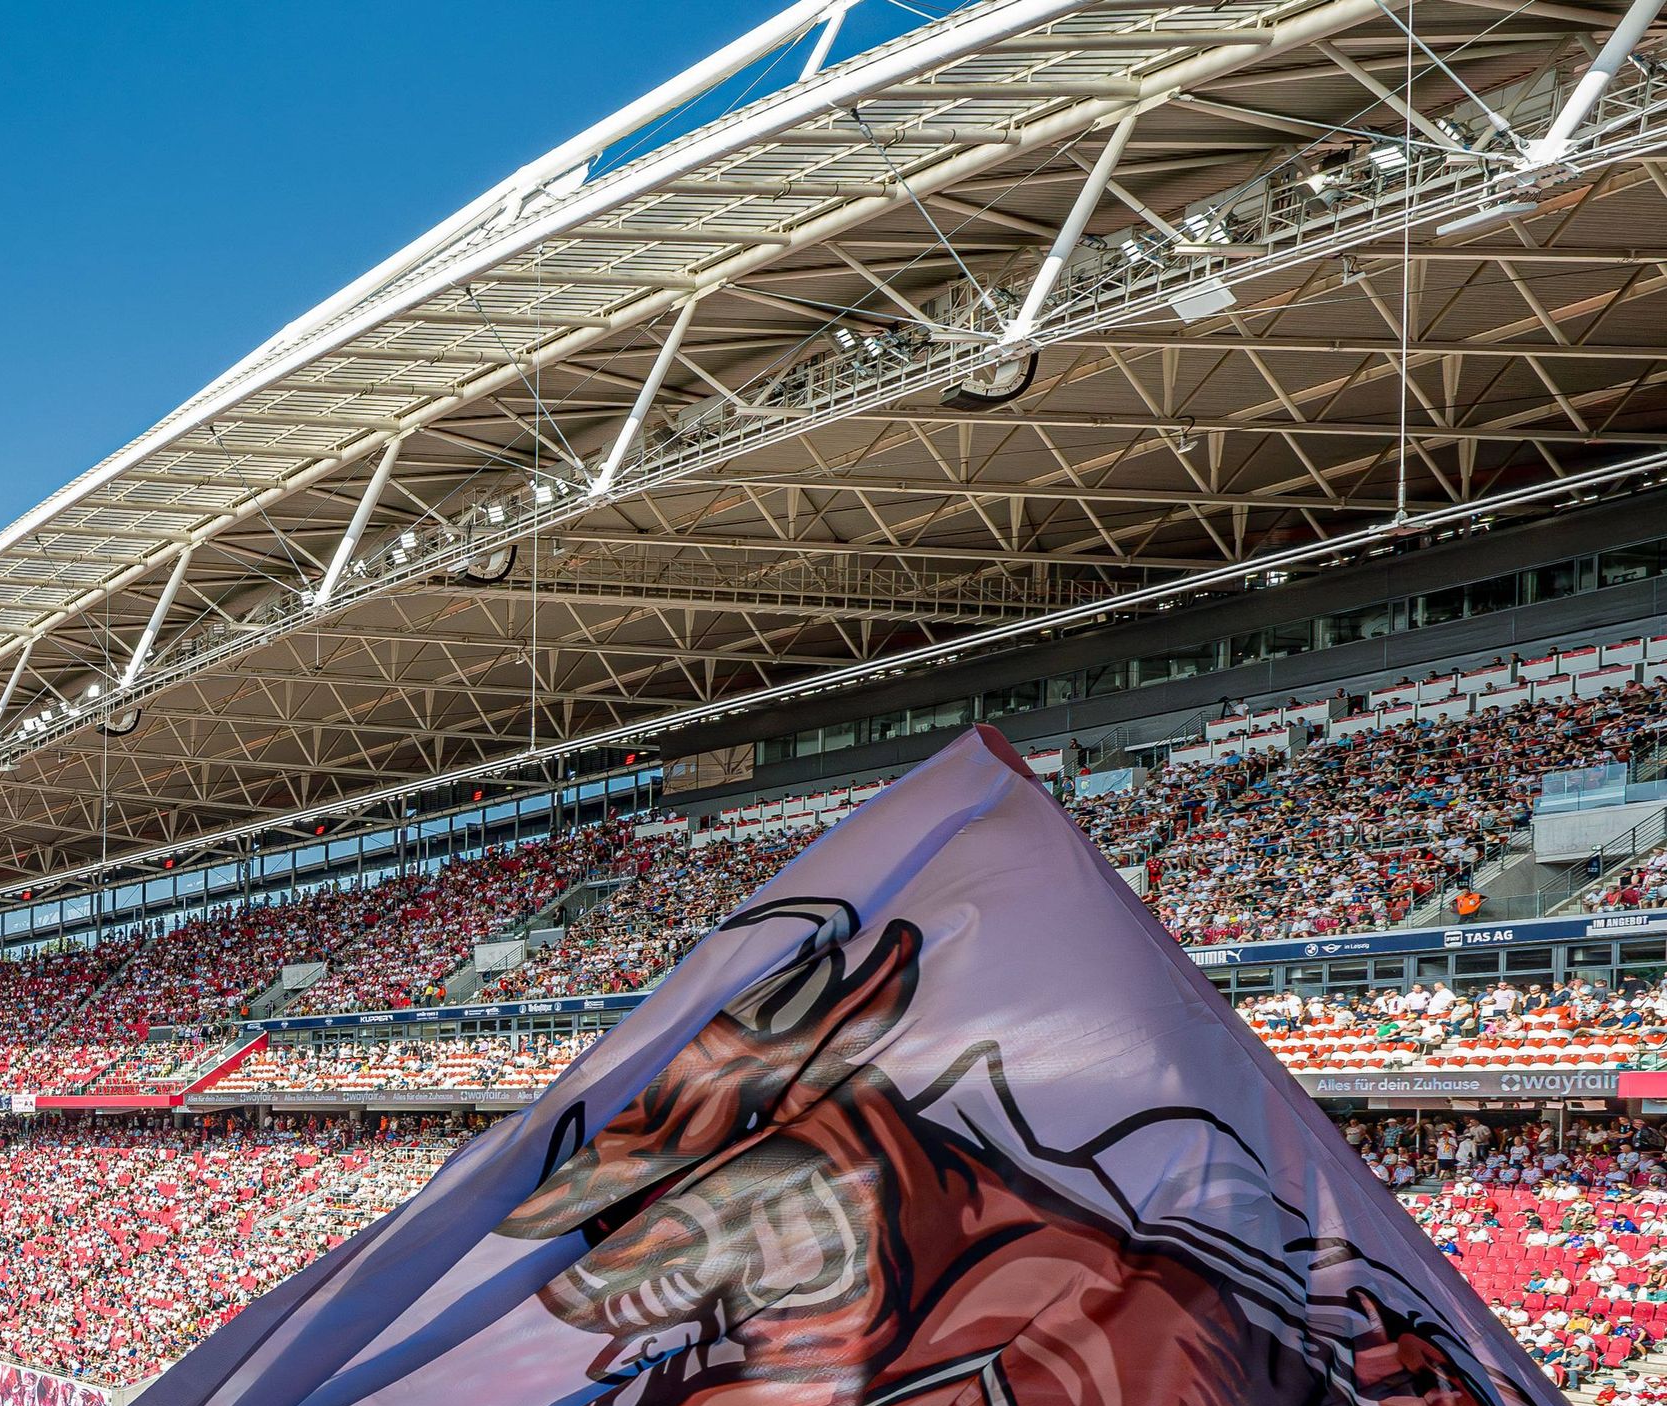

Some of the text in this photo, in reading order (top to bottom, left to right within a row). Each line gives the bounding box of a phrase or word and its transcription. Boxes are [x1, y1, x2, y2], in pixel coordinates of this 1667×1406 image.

[1605, 915, 1648, 928] ANGEBOT
[1465, 930, 1513, 943] TAS AG
[1317, 1077, 1481, 1091] Alles für dein Zuhause
